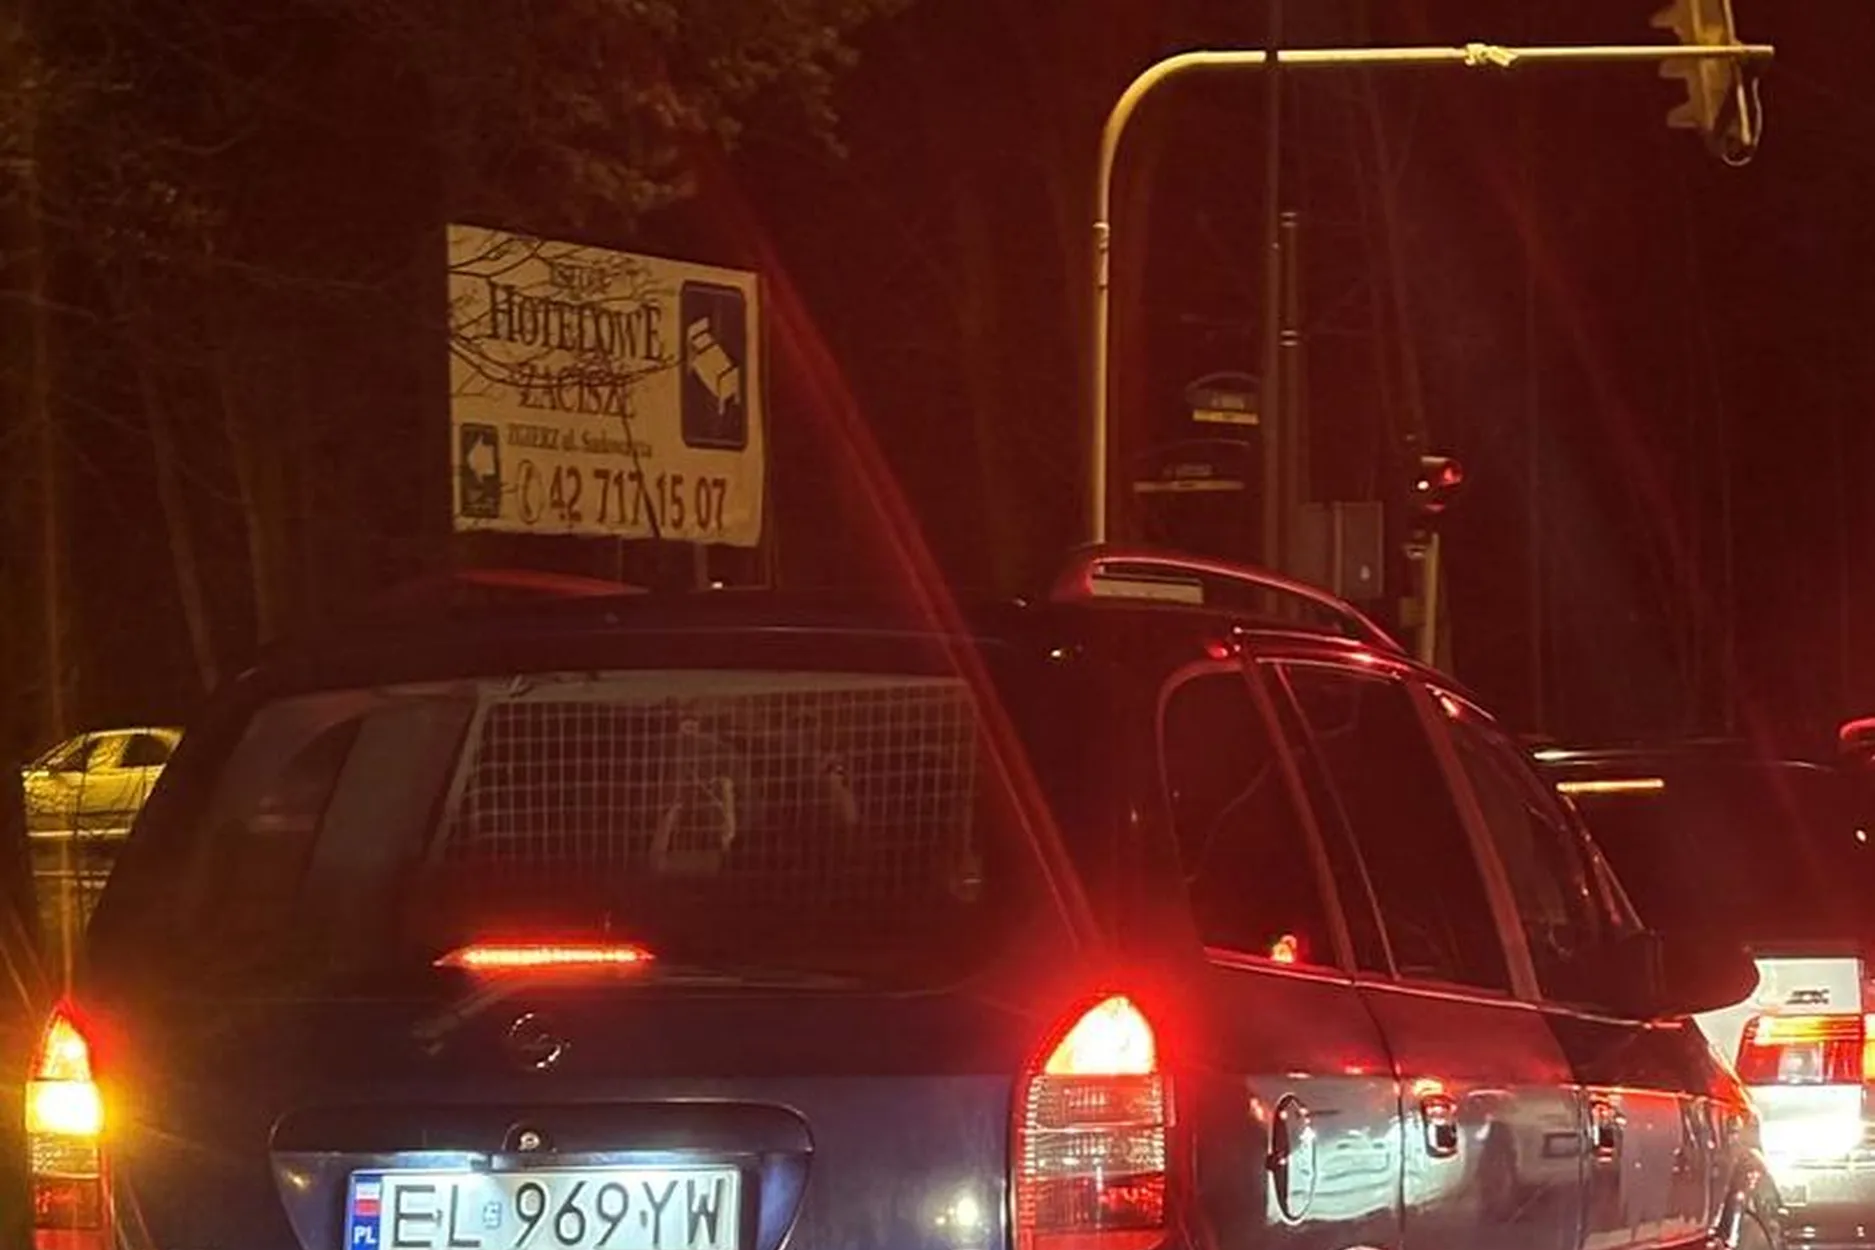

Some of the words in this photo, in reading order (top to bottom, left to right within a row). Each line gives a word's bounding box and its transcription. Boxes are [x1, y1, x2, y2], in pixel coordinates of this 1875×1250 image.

[488, 281, 663, 361] HOTELOWE
[551, 465, 582, 522] 42
[594, 469, 643, 526] 717
[656, 473, 685, 529] 15
[696, 477, 726, 531] 07
[353, 1226, 376, 1245] PL
[391, 1183, 481, 1248] EL
